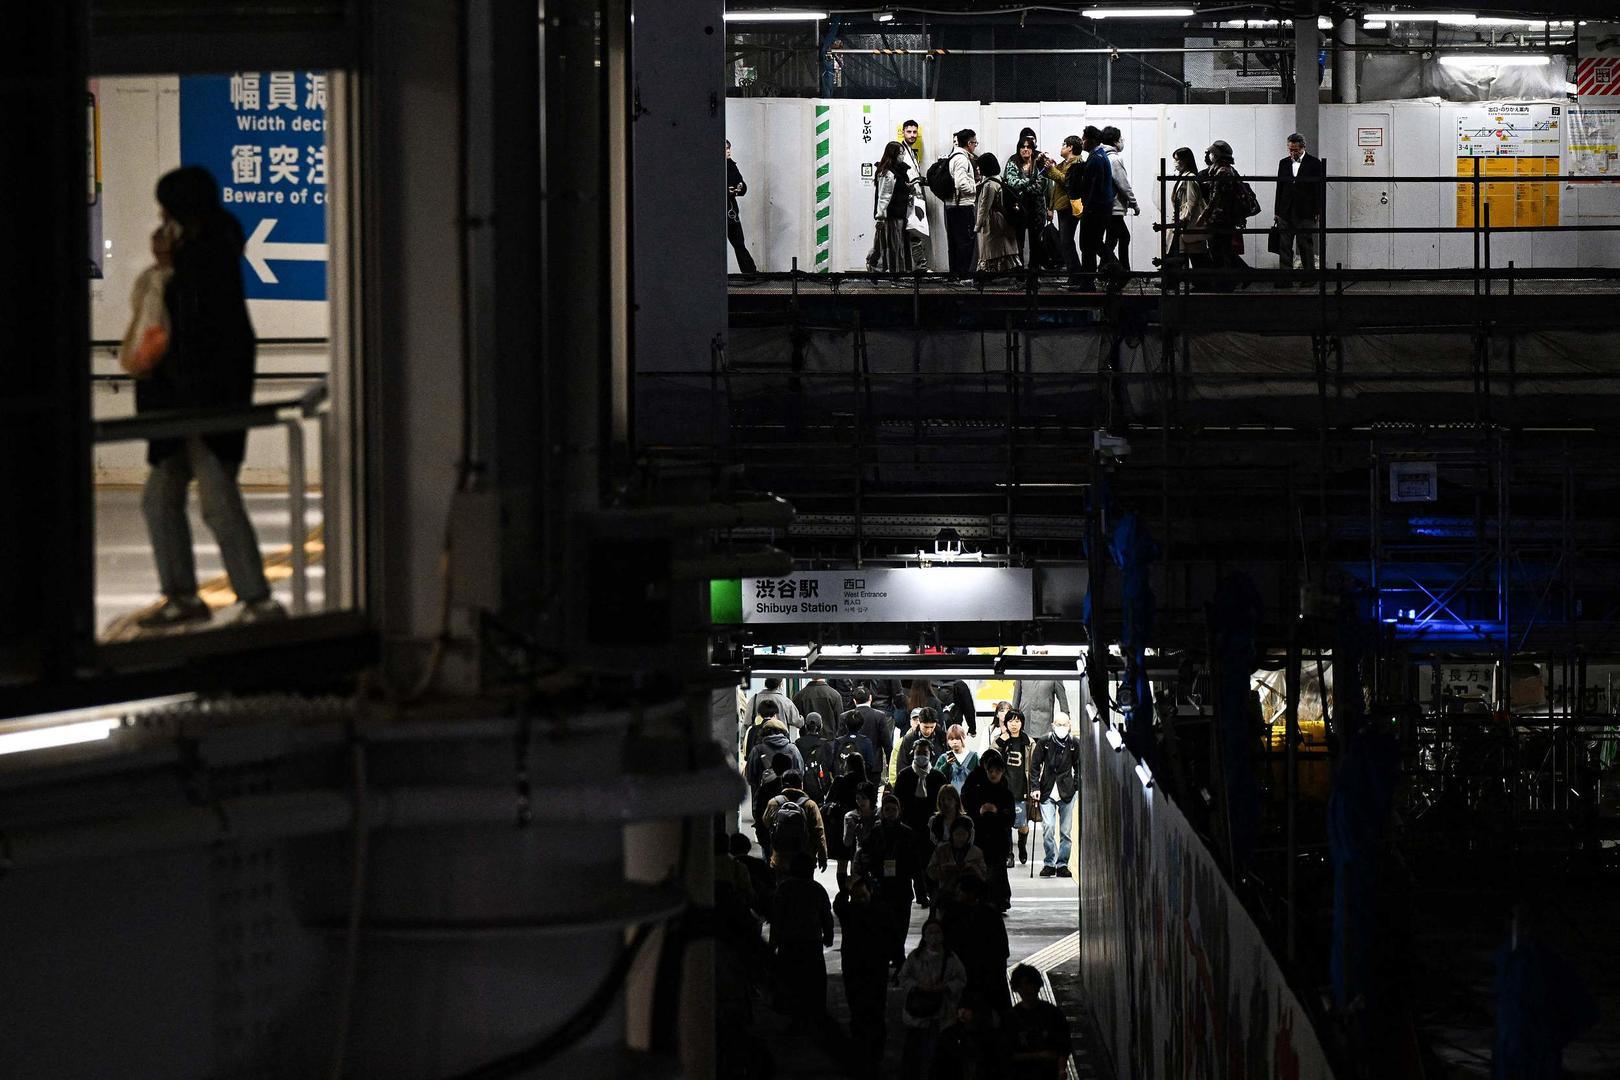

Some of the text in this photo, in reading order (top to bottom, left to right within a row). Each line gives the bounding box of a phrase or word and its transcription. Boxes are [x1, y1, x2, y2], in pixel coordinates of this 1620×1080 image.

[236, 115, 286, 132] Width
[862, 116, 872, 144] しぶや
[231, 144, 328, 185] 衝突注
[223, 186, 285, 204] Beware
[290, 187, 308, 205] of
[756, 579, 819, 599] 渋谷駅
[844, 578, 866, 590] 西口
[756, 602, 838, 615] Shibuya Station
[1007, 751, 1022, 767] B
